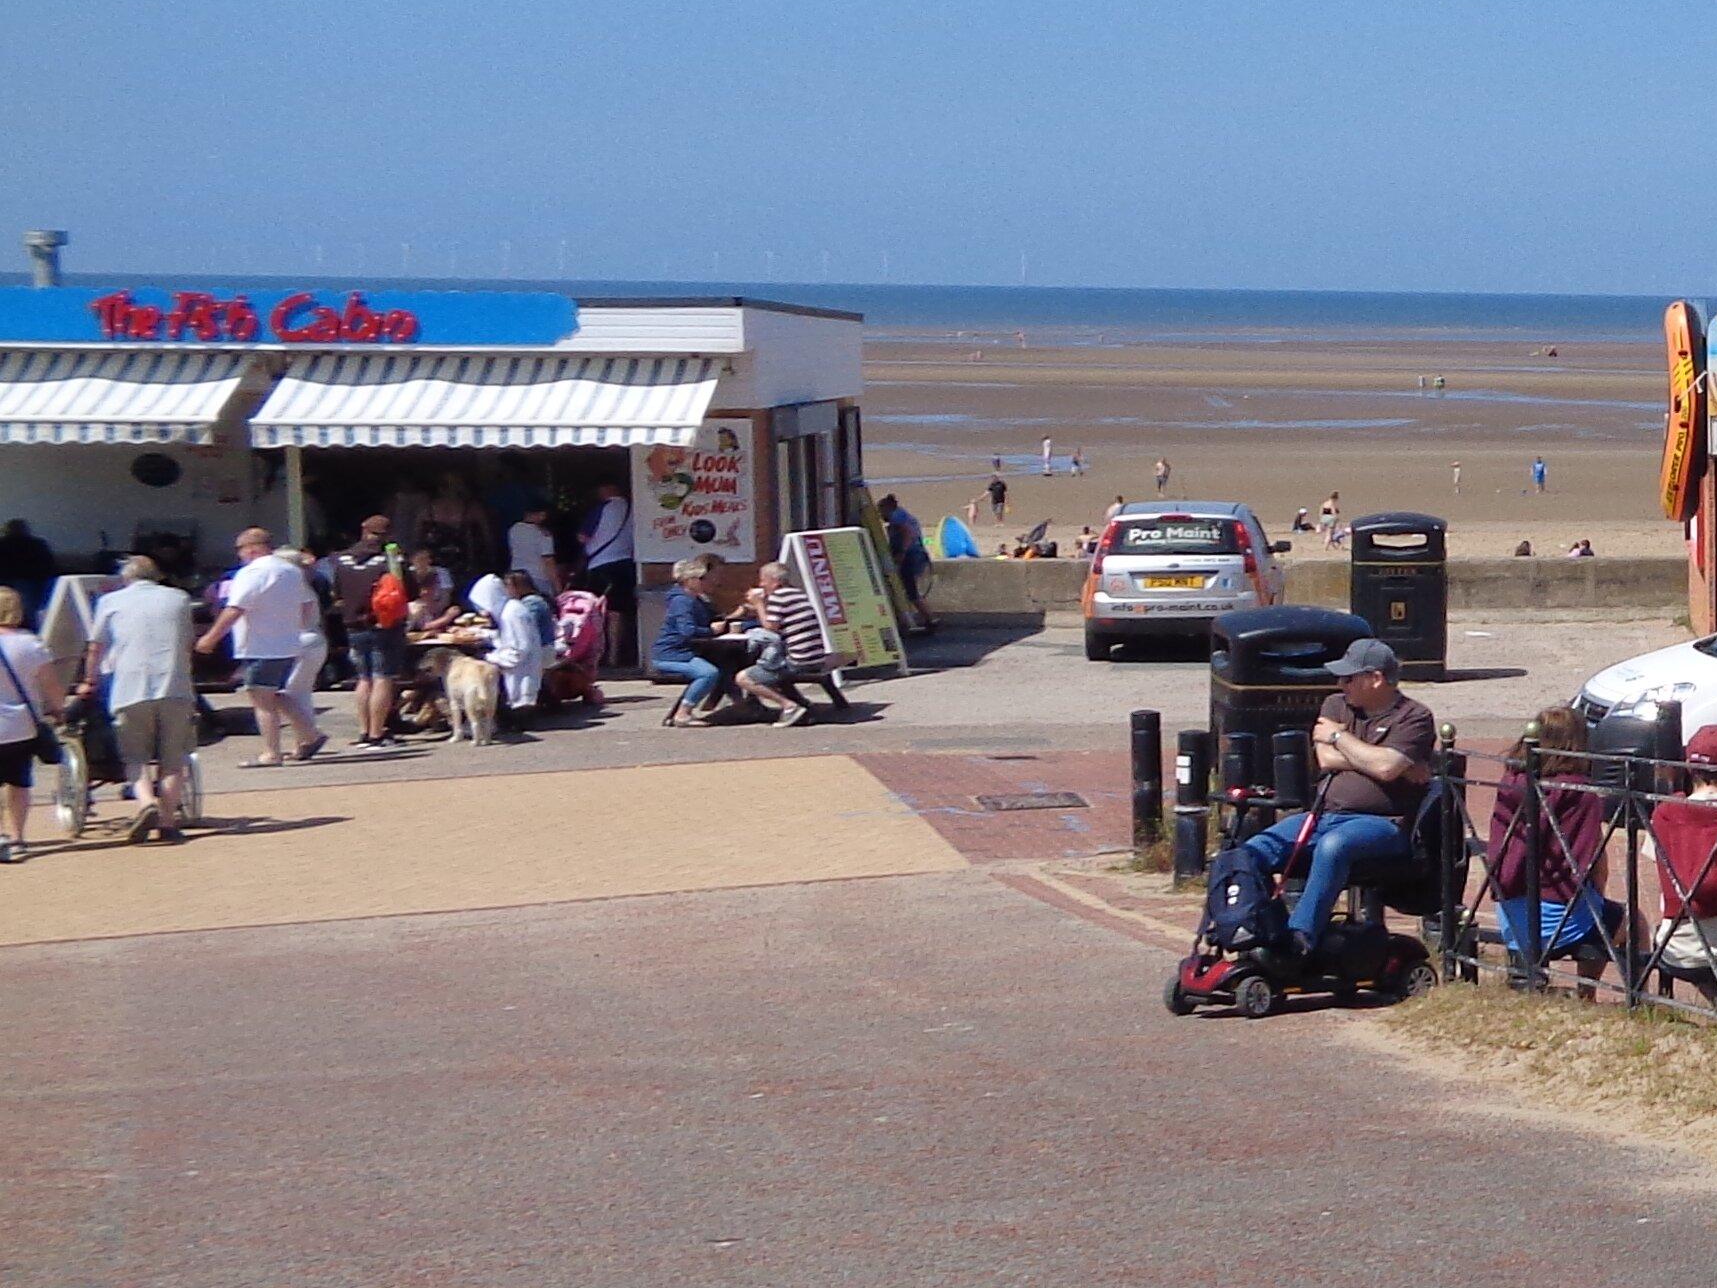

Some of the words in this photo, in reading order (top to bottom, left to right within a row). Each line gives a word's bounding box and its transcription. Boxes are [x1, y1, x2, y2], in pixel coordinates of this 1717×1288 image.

[692, 453, 742, 473] LOOK
[693, 476, 737, 495] MUM
[1128, 528, 1163, 541] Pro
[1166, 526, 1222, 540] Maint
[804, 537, 843, 620] MENU
